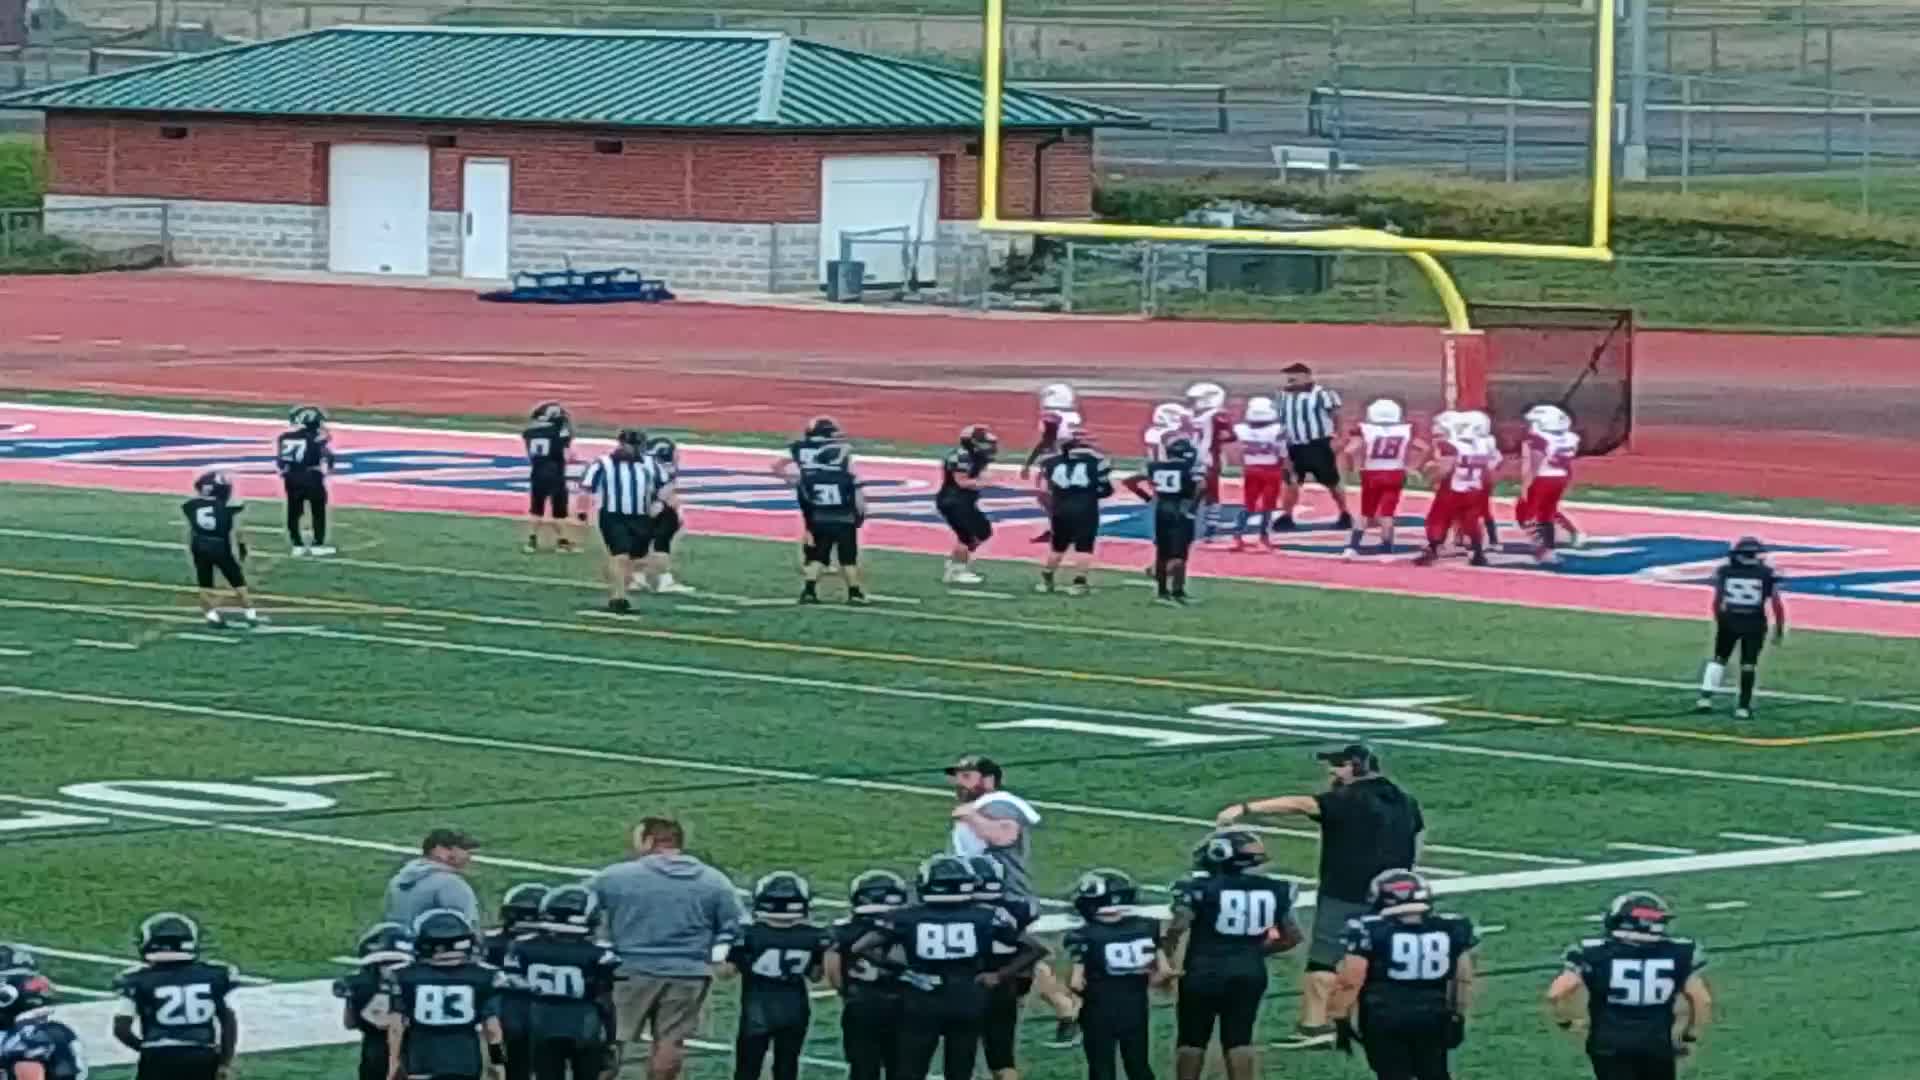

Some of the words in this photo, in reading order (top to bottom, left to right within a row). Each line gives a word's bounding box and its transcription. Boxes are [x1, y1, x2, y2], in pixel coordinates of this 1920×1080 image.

[813, 484, 842, 505] 31
[1051, 463, 1089, 488] 44
[196, 506, 216, 530] 6
[1221, 890, 1272, 936] 80
[917, 923, 978, 960] 89
[1387, 932, 1450, 980] 98
[752, 949, 812, 977] 47
[1607, 958, 1676, 1006] 56
[155, 983, 214, 1026] 26
[414, 984, 475, 1025] 83
